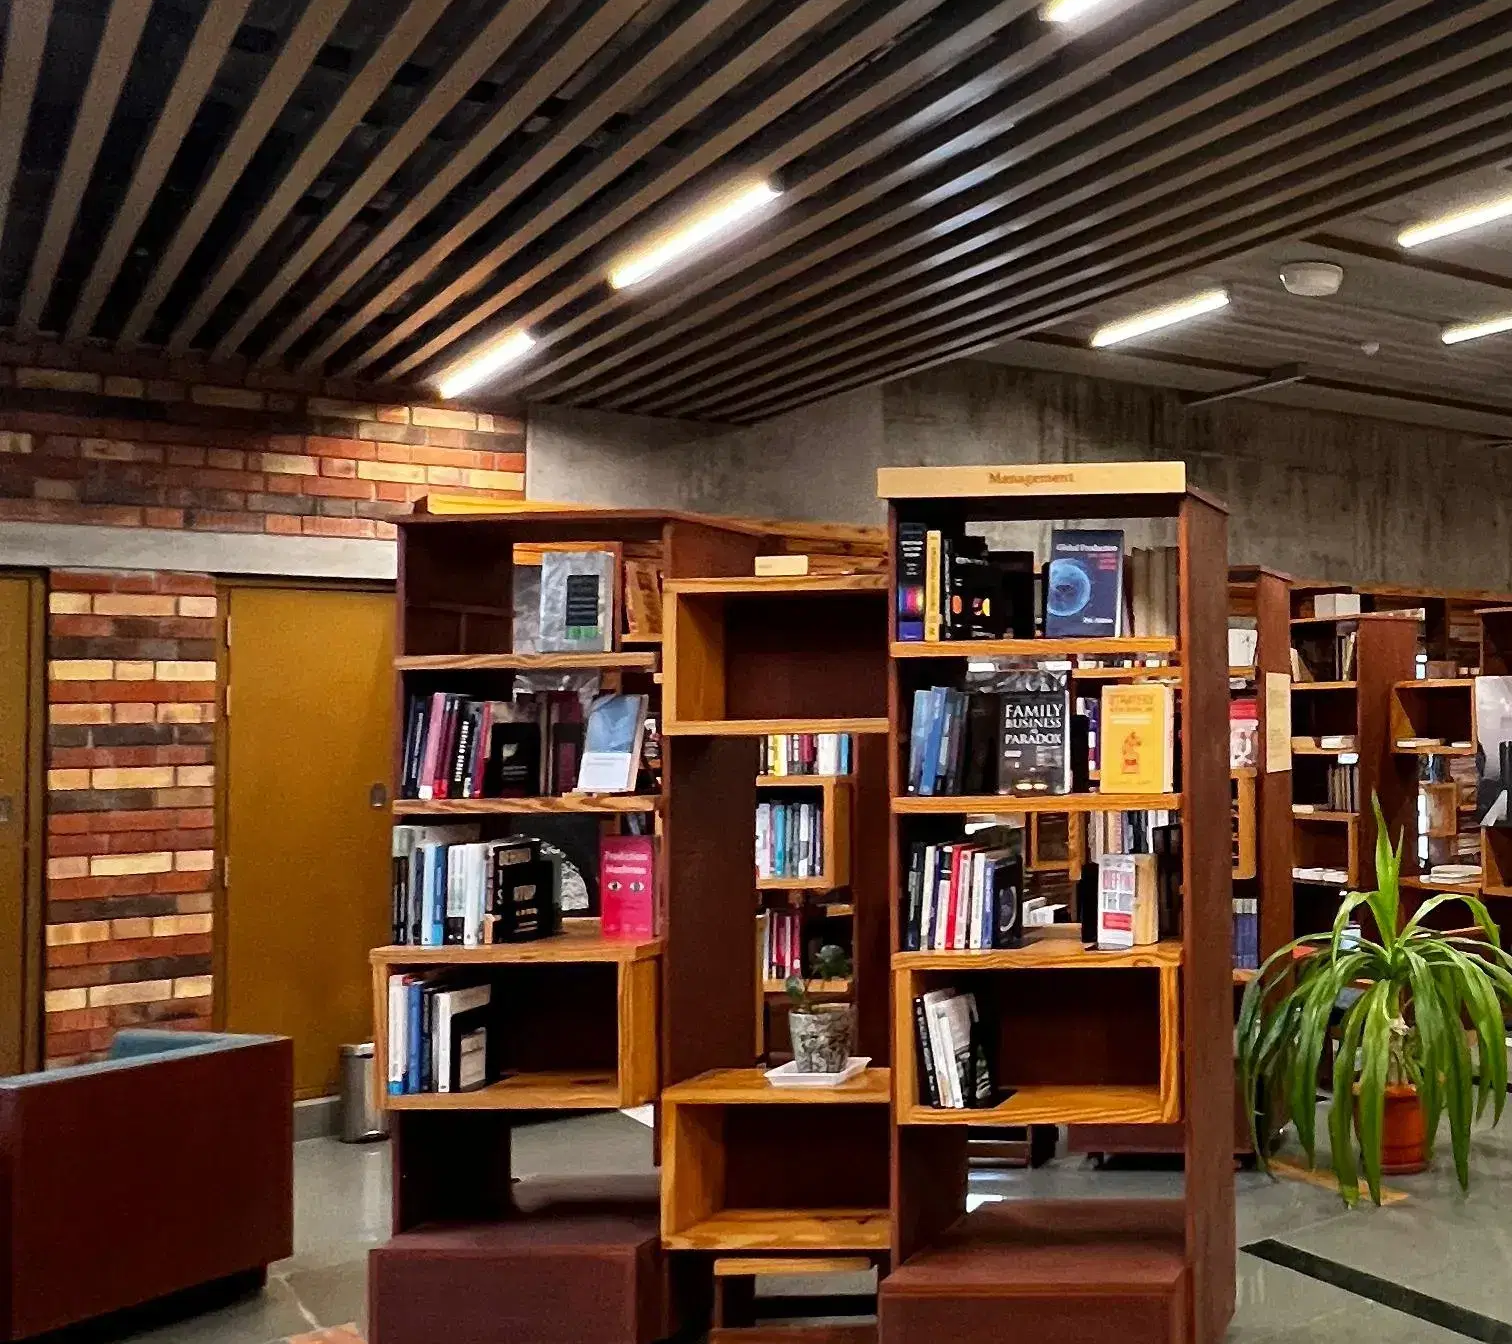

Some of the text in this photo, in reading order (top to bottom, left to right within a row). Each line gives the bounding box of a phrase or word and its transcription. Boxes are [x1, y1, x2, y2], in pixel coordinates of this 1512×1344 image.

[1005, 704, 1063, 718] FAMILY
[1005, 718, 1062, 728] BUSINESS
[1004, 733, 1062, 745] PARADOX
